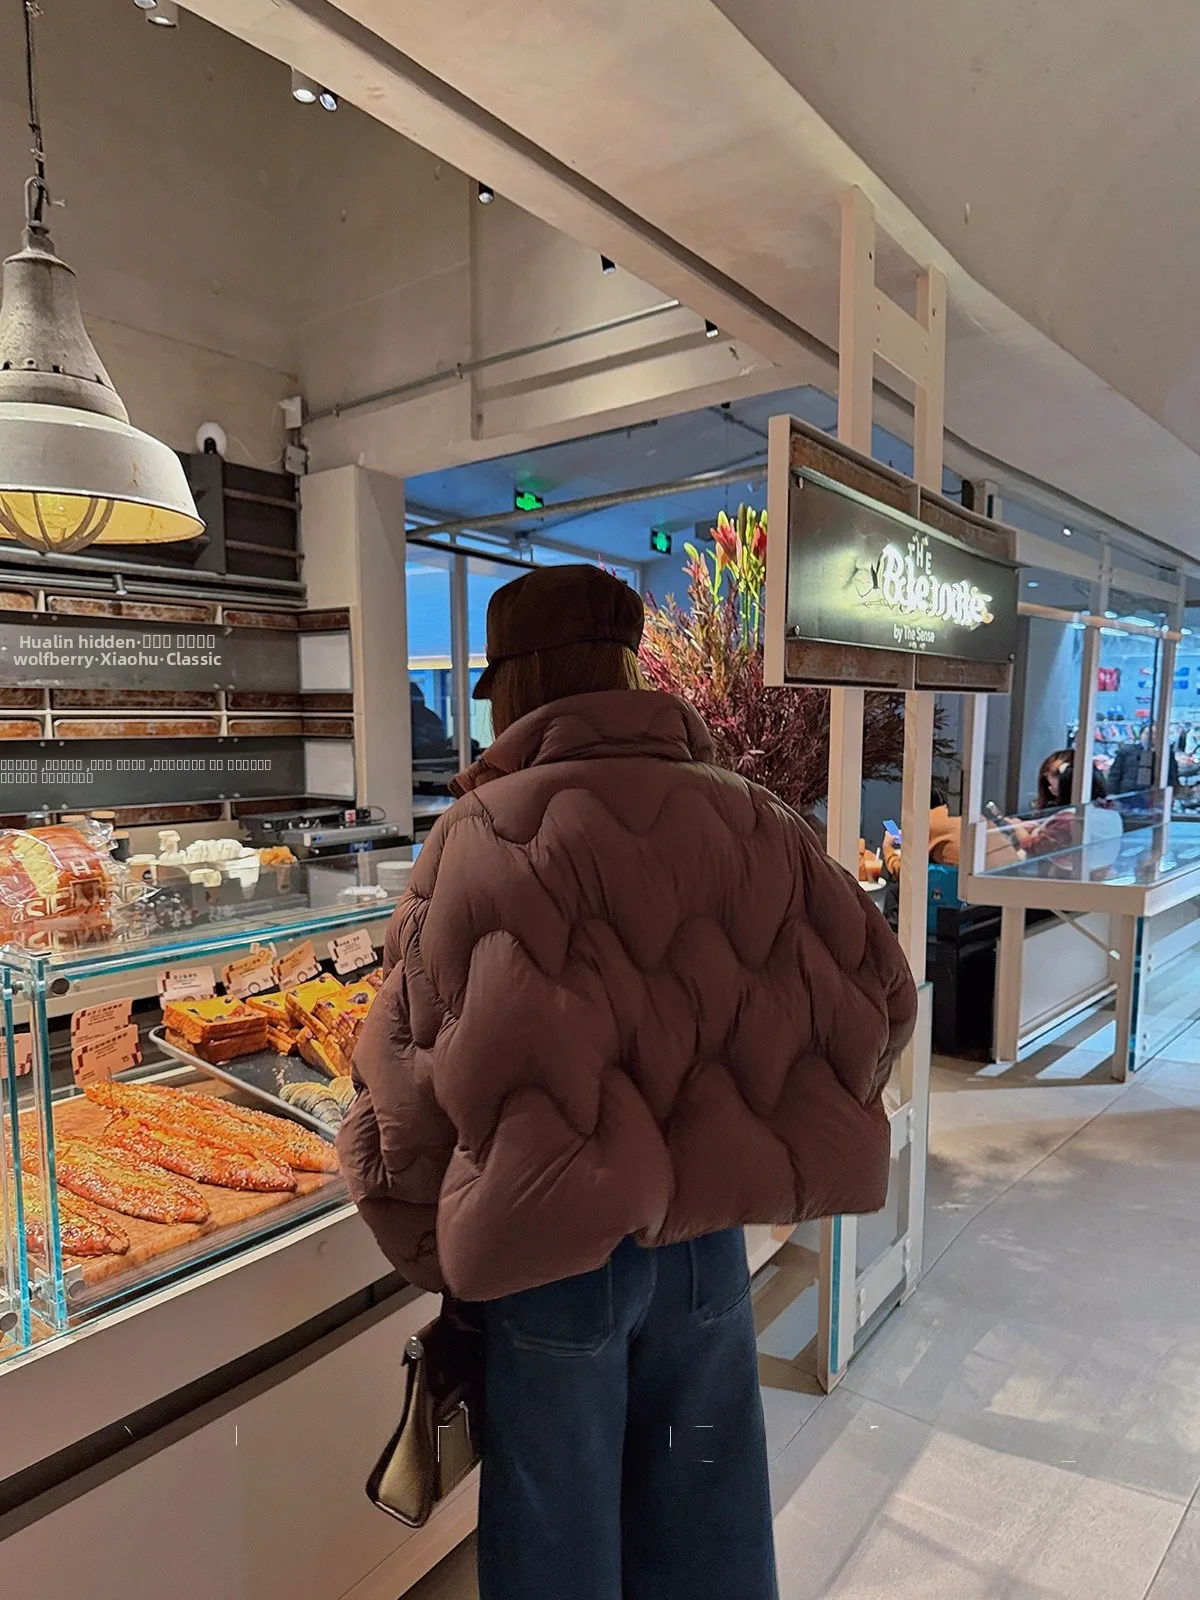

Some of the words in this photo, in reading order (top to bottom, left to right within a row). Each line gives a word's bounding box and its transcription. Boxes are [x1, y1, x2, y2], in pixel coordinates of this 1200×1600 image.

[893, 624, 903, 643] by
[904, 625, 915, 641] The
[916, 627, 935, 644] Sense
